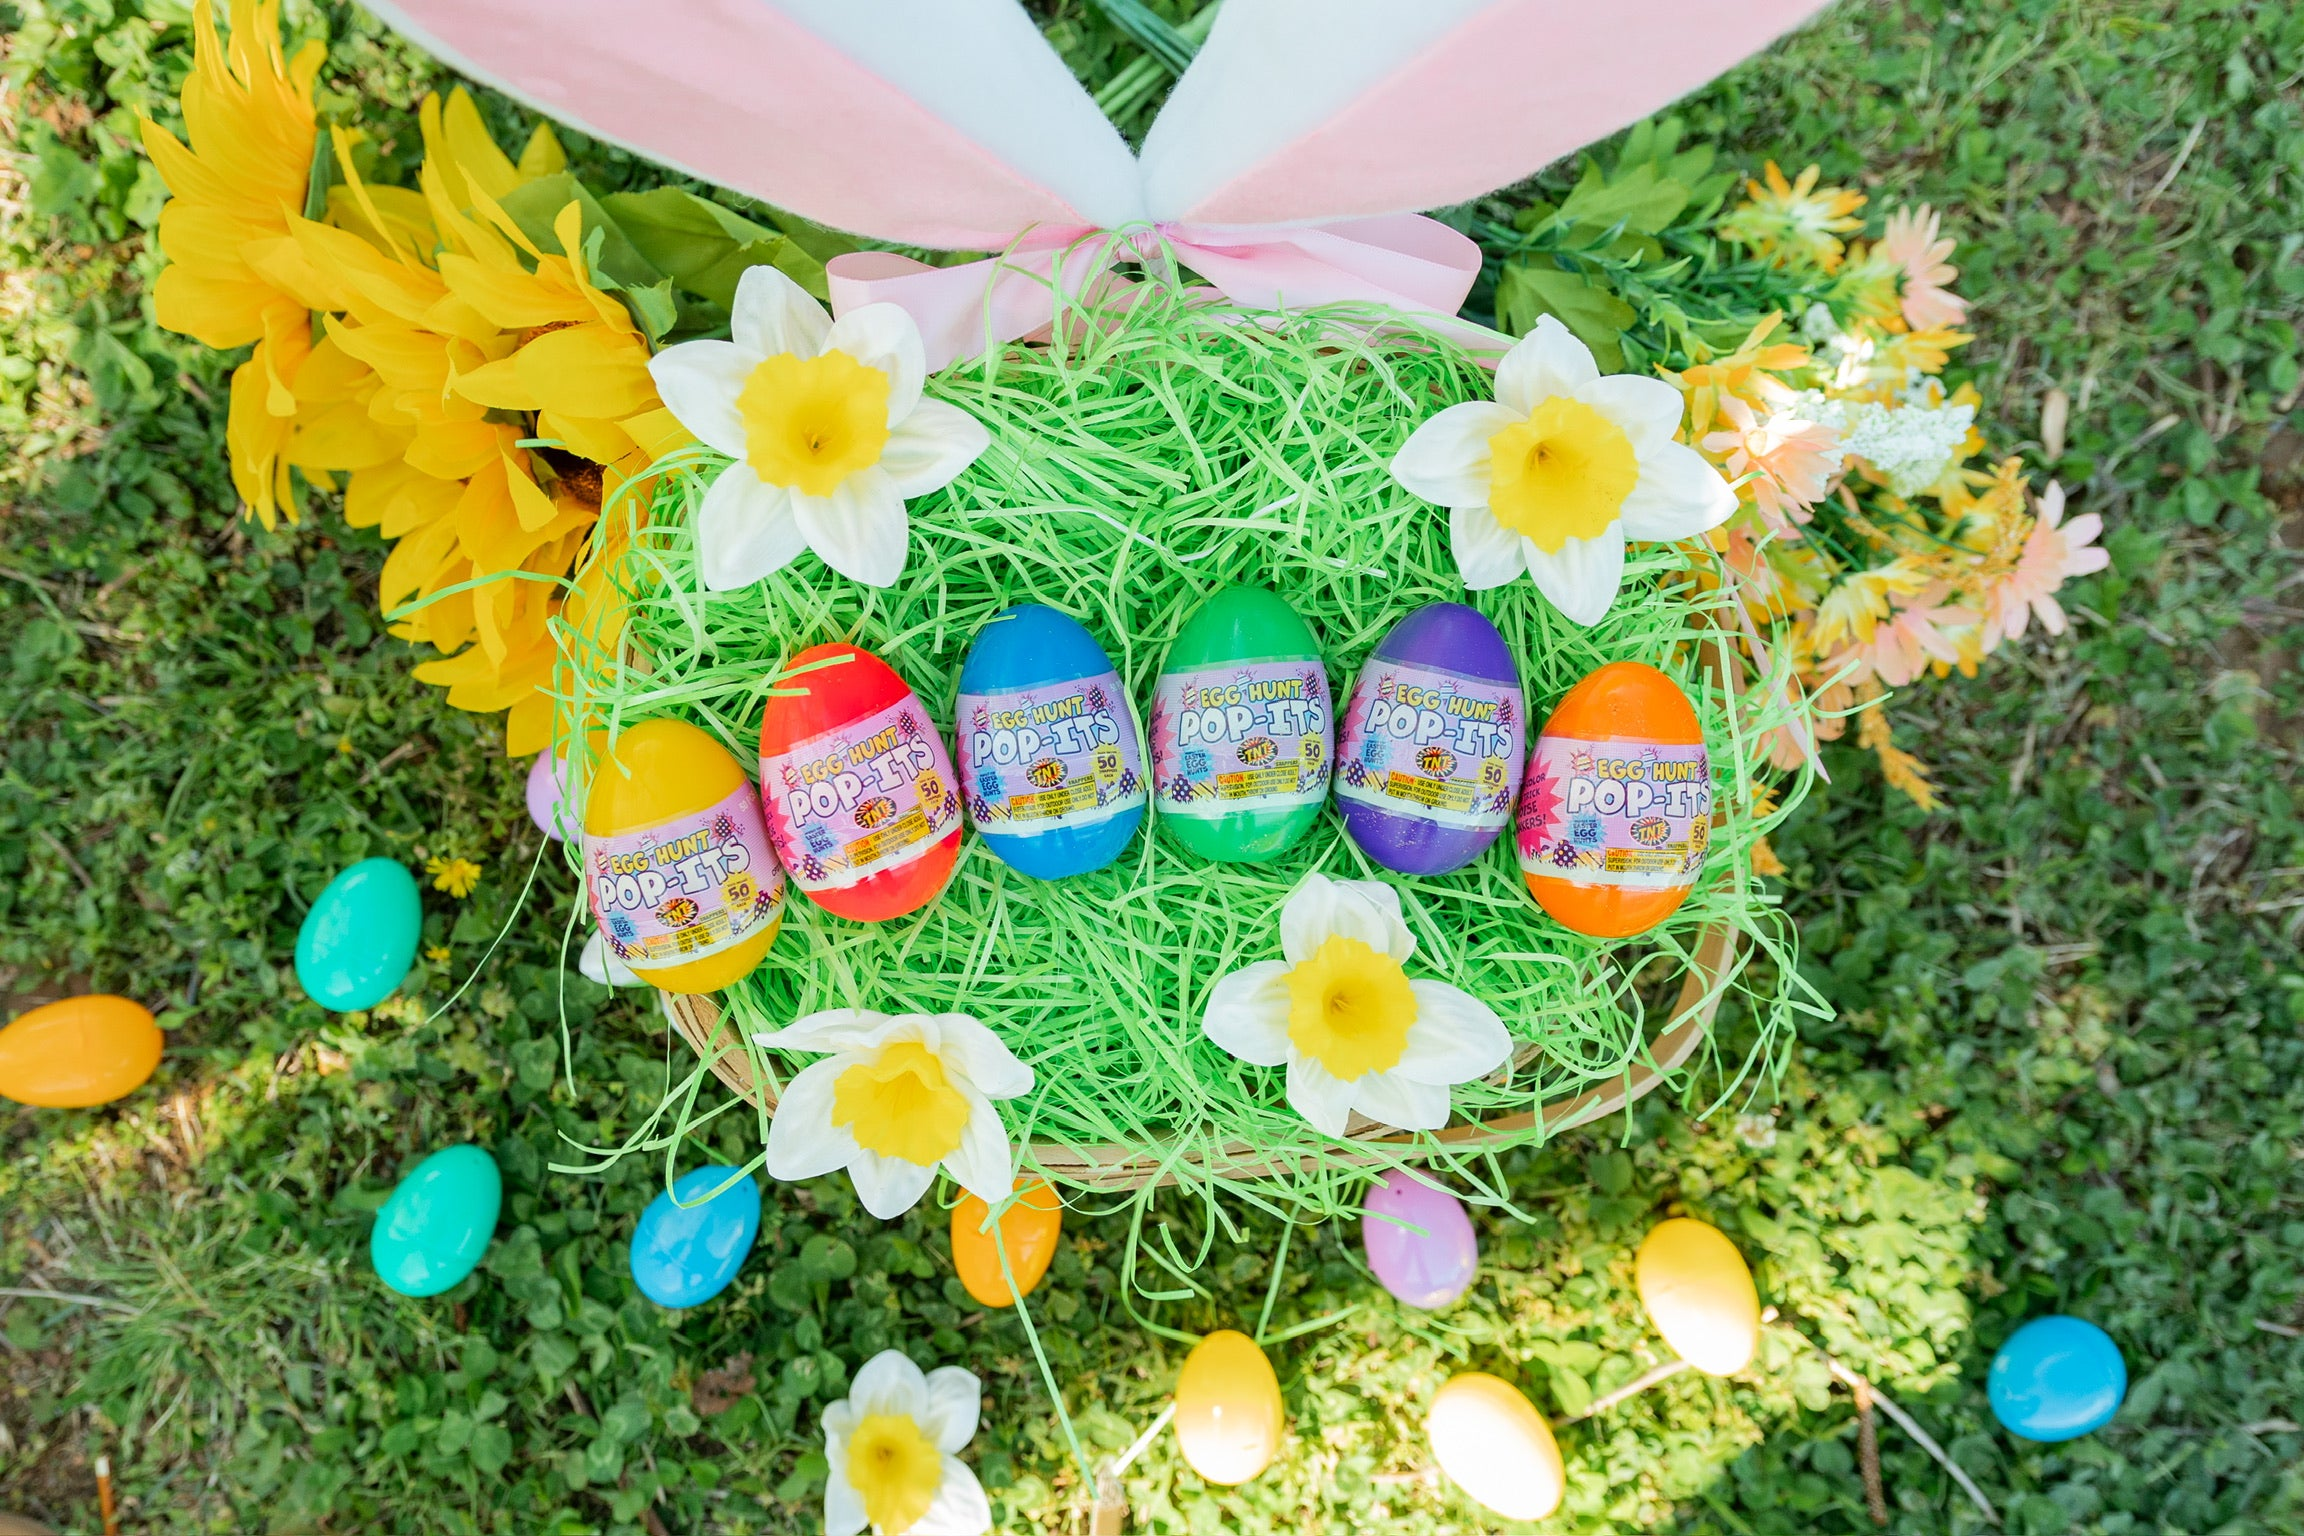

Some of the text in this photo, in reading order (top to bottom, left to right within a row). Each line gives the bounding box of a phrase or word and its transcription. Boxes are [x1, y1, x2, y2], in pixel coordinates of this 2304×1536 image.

[1201, 679, 1303, 708] EGG HUNT
[1396, 684, 1498, 721] EGG HUNT
[991, 695, 1085, 730] EGG HUNT
[1178, 696, 1326, 747] POP-ITS
[973, 708, 1120, 768] POP-ITS
[1364, 699, 1513, 760] POP-ITS
[800, 726, 897, 785] EGG HUNT
[1244, 744, 1270, 761] TNT
[1305, 743, 1320, 758] 50
[1366, 749, 1384, 757] EGG
[1098, 755, 1116, 769] 50
[1186, 759, 1207, 768] EGG
[1423, 757, 1449, 770] TNT
[1597, 759, 1698, 781] EGG HUNT
[788, 734, 935, 828] POP-ITS
[1034, 764, 1058, 784] TNT
[1068, 775, 1093, 786] SNAPPERS
[1218, 774, 1244, 784] CAUTION
[1485, 766, 1502, 783] 50
[920, 781, 939, 797] 50
[982, 781, 999, 790] EGG
[1567, 777, 1711, 819] POP-ITS
[863, 802, 887, 828] TNT
[1518, 800, 1538, 818] OISE
[1517, 813, 1546, 834] AKERS!
[1638, 823, 1663, 841] TNT
[1693, 825, 1706, 839] 50
[810, 835, 829, 848] EGG
[1574, 829, 1596, 837] EGG
[610, 829, 711, 876] EGG HUNT
[599, 836, 750, 912] POP-ITS
[728, 883, 750, 901] 50
[664, 901, 691, 923] TNT
[614, 924, 631, 932] EGG
